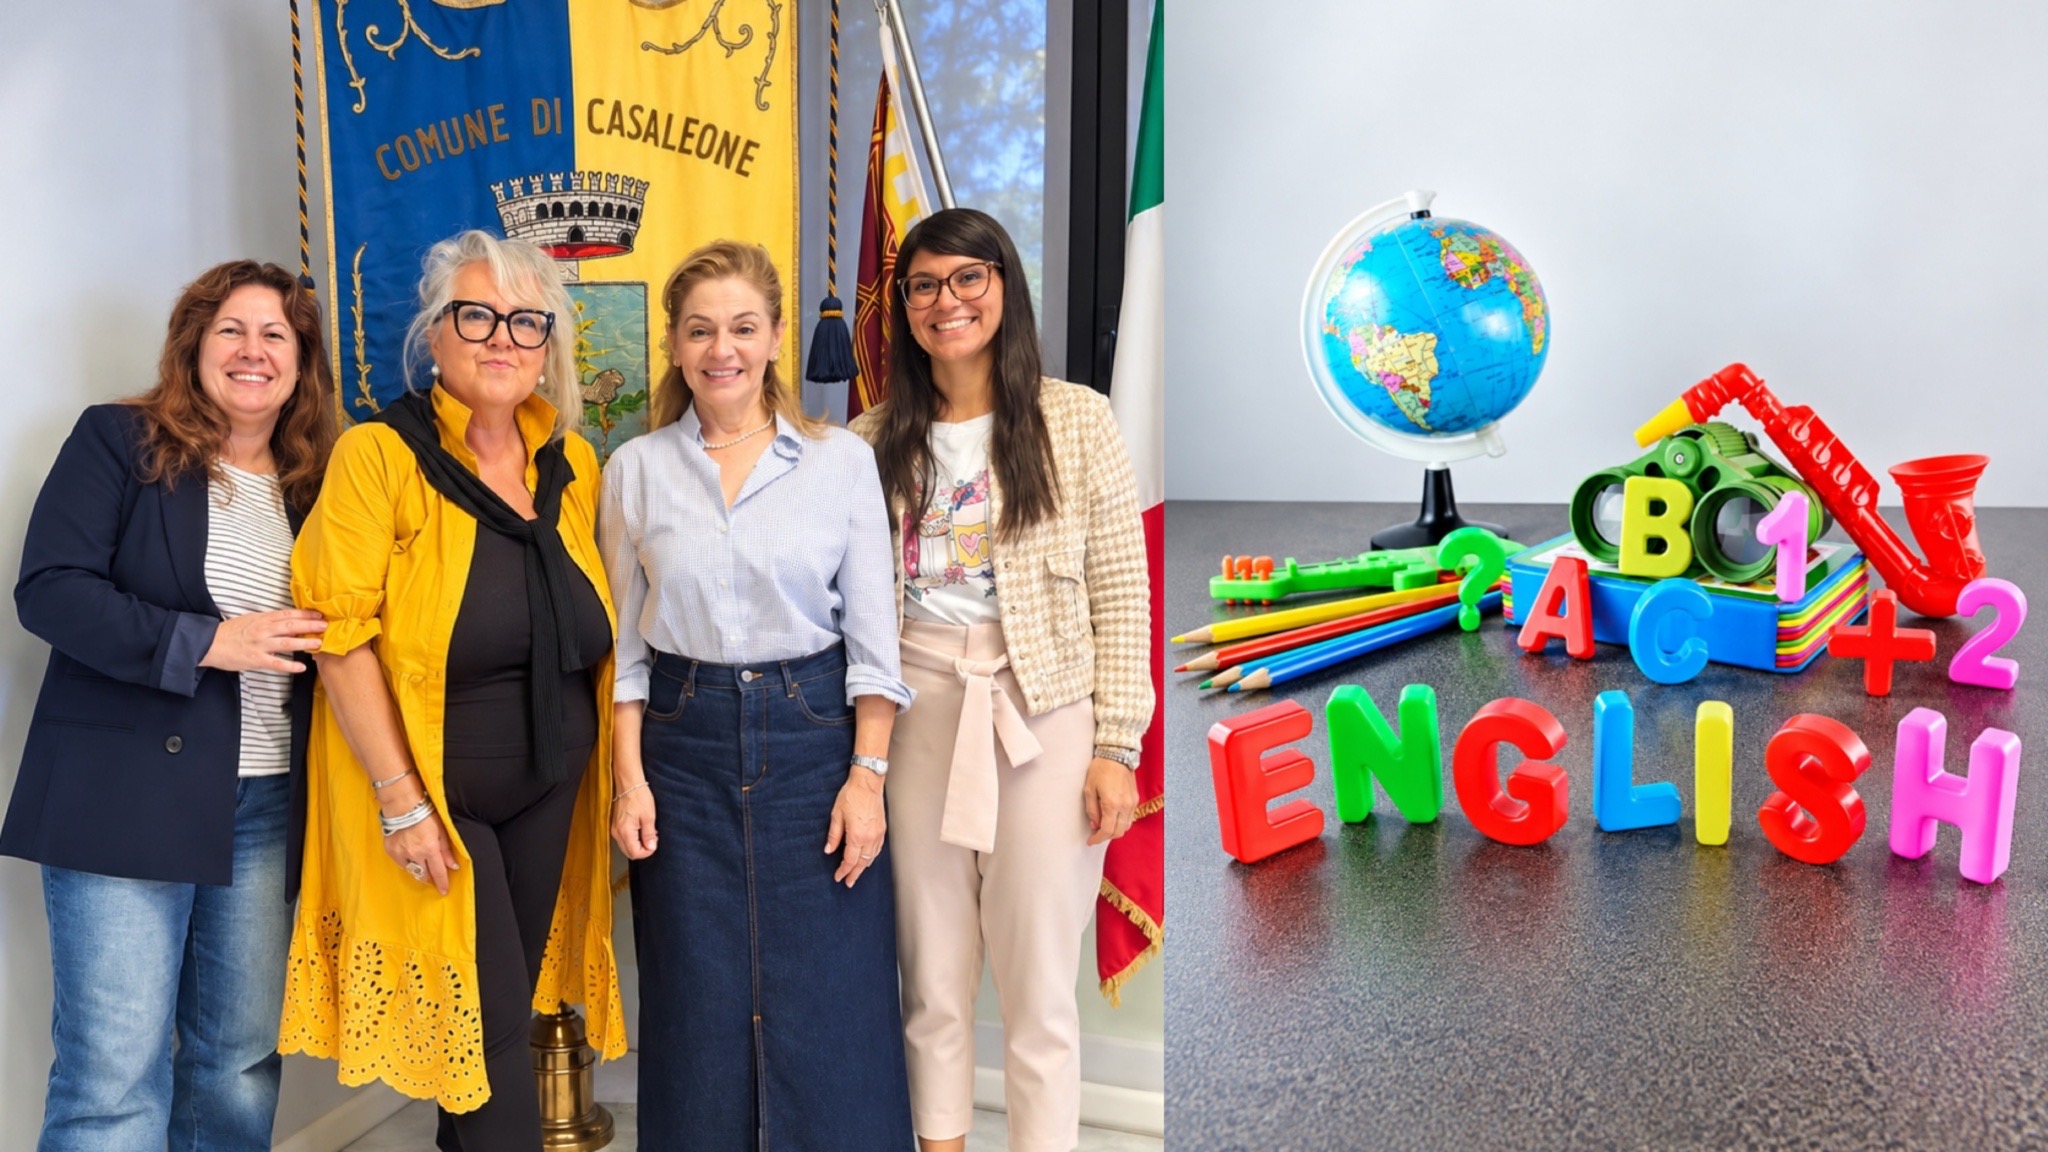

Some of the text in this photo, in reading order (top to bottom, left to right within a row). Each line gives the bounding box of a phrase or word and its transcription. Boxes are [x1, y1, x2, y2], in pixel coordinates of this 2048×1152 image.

[375, 97, 761, 182] COMUNE DI CASALEONE
[1436, 527, 1507, 632] ?
[1618, 476, 1694, 577] B
[1756, 490, 1809, 602] 1
[1517, 556, 1595, 660] A
[1629, 577, 1713, 685] C
[1827, 589, 1937, 697] +
[1948, 577, 2028, 690] 2
[1207, 683, 2022, 885] ENGLISH
